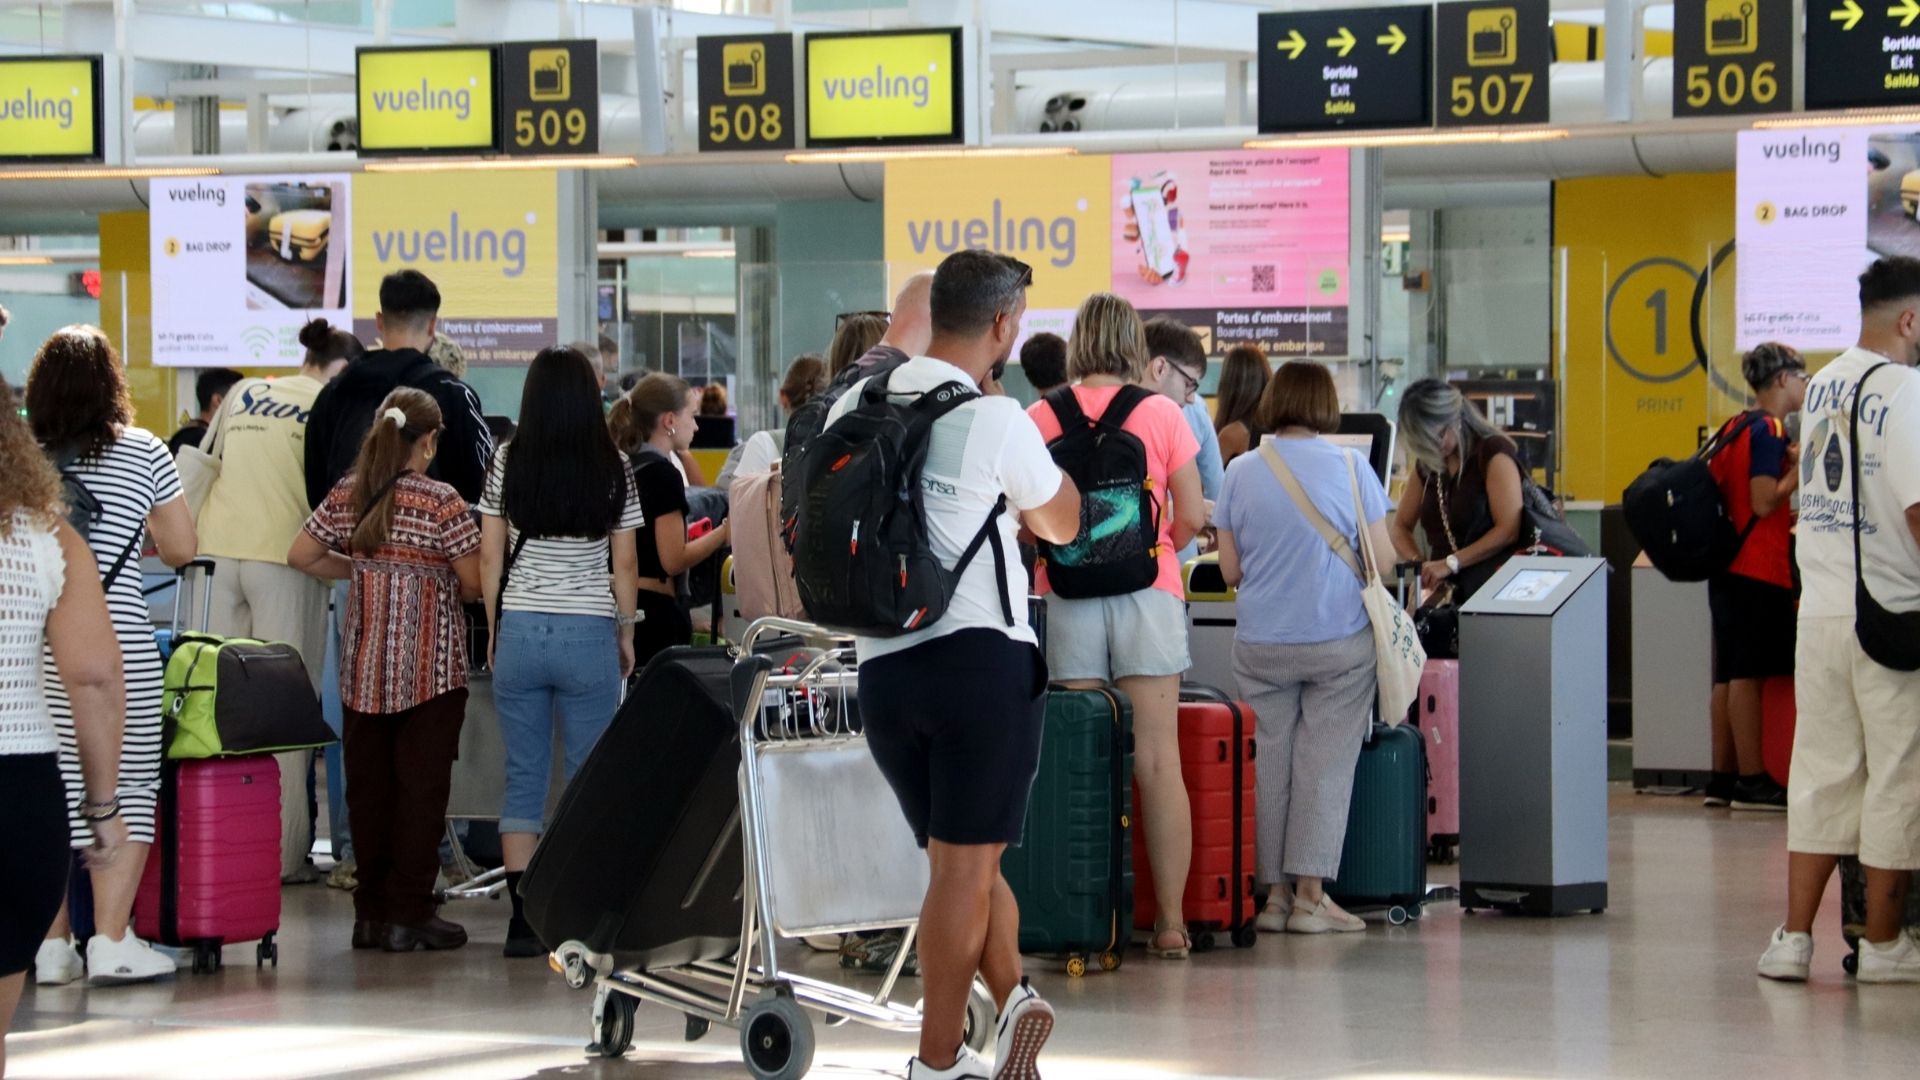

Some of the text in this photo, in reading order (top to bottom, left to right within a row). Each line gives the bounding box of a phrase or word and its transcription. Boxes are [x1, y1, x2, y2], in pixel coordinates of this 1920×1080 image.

[1890, 54, 1914, 70] Exit
[1322, 65, 1358, 80] Sortida
[1884, 73, 1920, 89] Salida
[823, 65, 930, 108] vueling
[1330, 83, 1350, 97] Exit
[1686, 62, 1777, 108] 506
[373, 78, 471, 120] vueling
[1451, 74, 1533, 117] 507
[0, 87, 72, 128] ueling
[1324, 101, 1355, 115] Salida
[514, 110, 586, 147] 509
[709, 103, 783, 143] 508
[1763, 137, 1841, 162] vueling
[168, 184, 226, 207] vueling
[1762, 204, 1847, 219] 2 BAG DROP
[169, 241, 232, 254] 2 BAG DROP
[373, 211, 527, 277] vueling
[1216, 312, 1249, 324] Portes
[1645, 289, 1665, 355] 1
[444, 321, 543, 335] Portes d'embarcament
[1216, 325, 1279, 338] Boarding gates
[1637, 398, 1683, 412] PRINT
